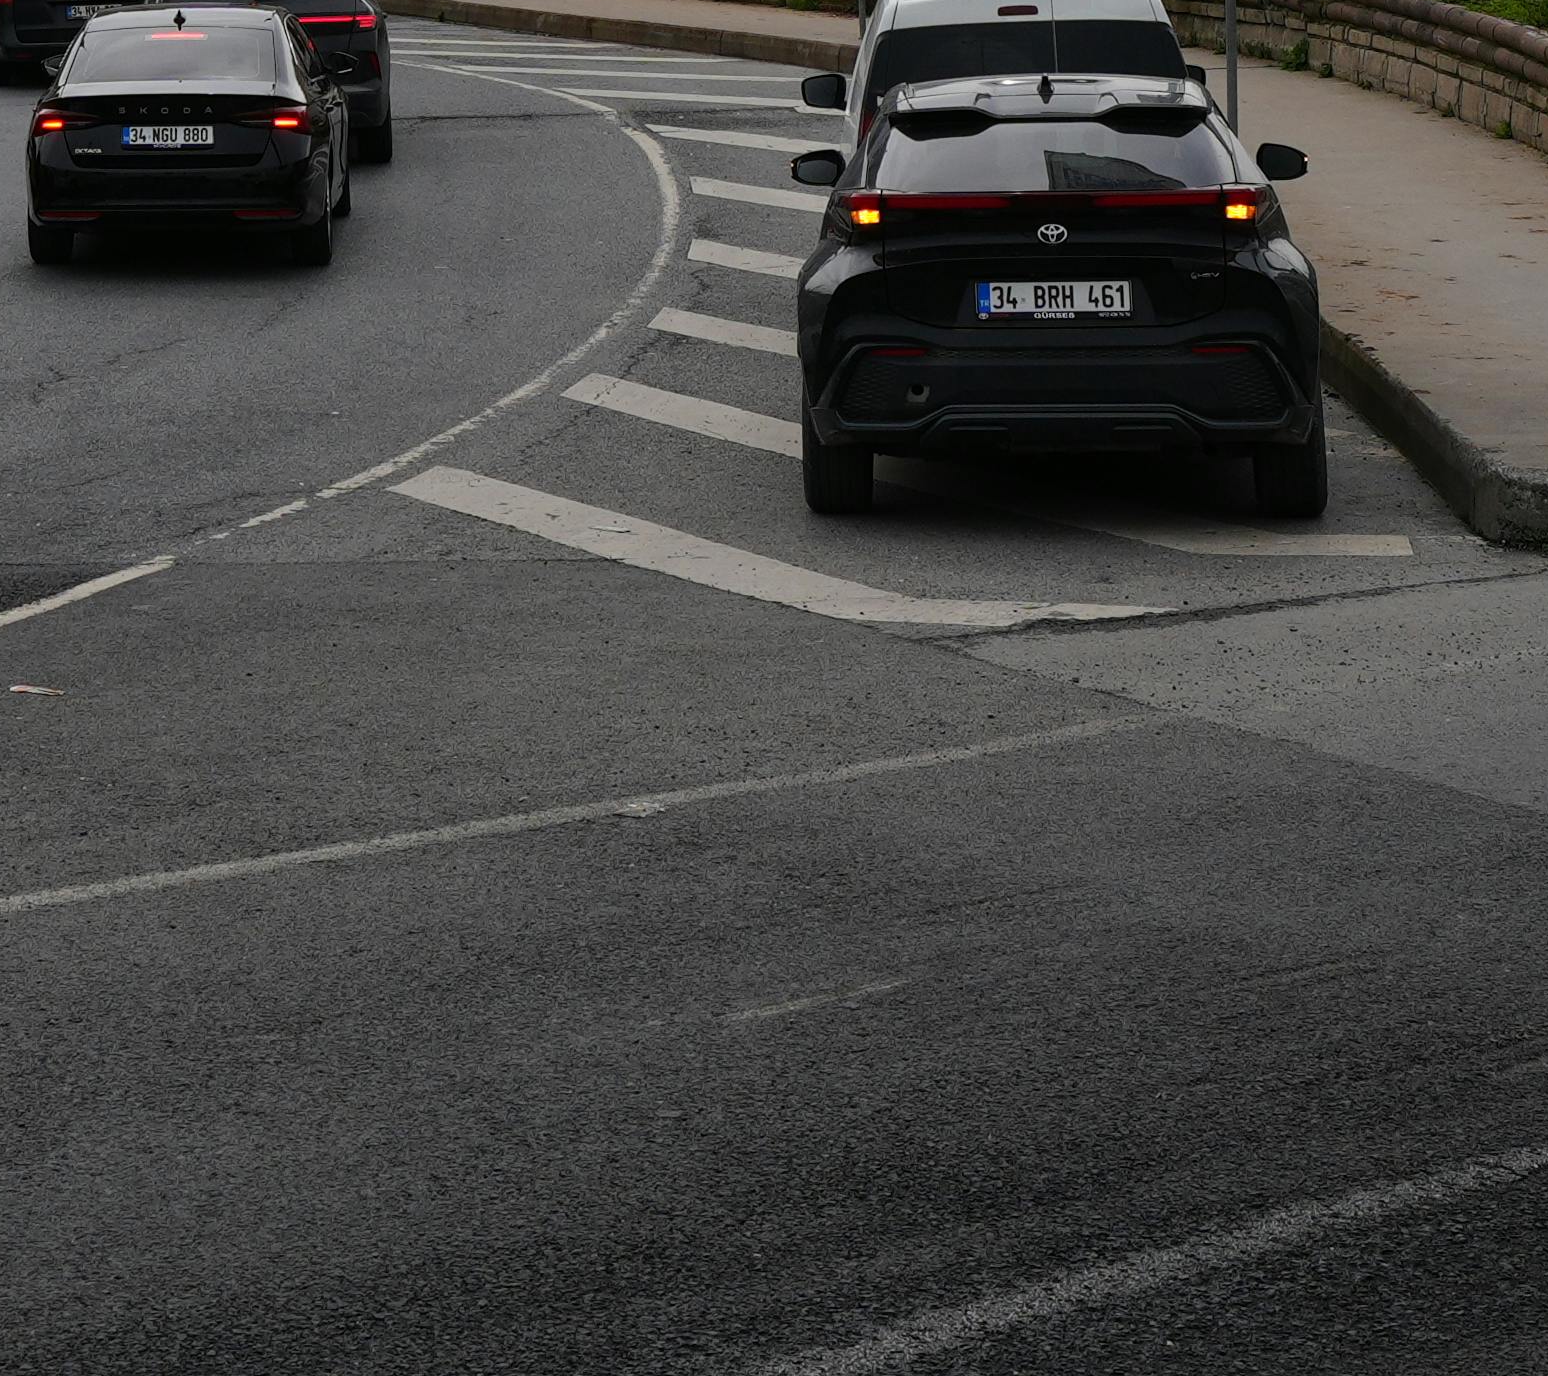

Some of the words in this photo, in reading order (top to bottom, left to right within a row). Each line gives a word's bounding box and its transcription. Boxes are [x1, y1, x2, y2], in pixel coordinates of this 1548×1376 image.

[72, 7, 82, 16] 34
[118, 106, 213, 115] SKODA
[131, 128, 146, 142] 34
[152, 128, 177, 142] NGU
[184, 127, 208, 142] 880
[992, 285, 1018, 309] 34
[1034, 285, 1073, 309] BRH
[1089, 284, 1125, 308] 461
